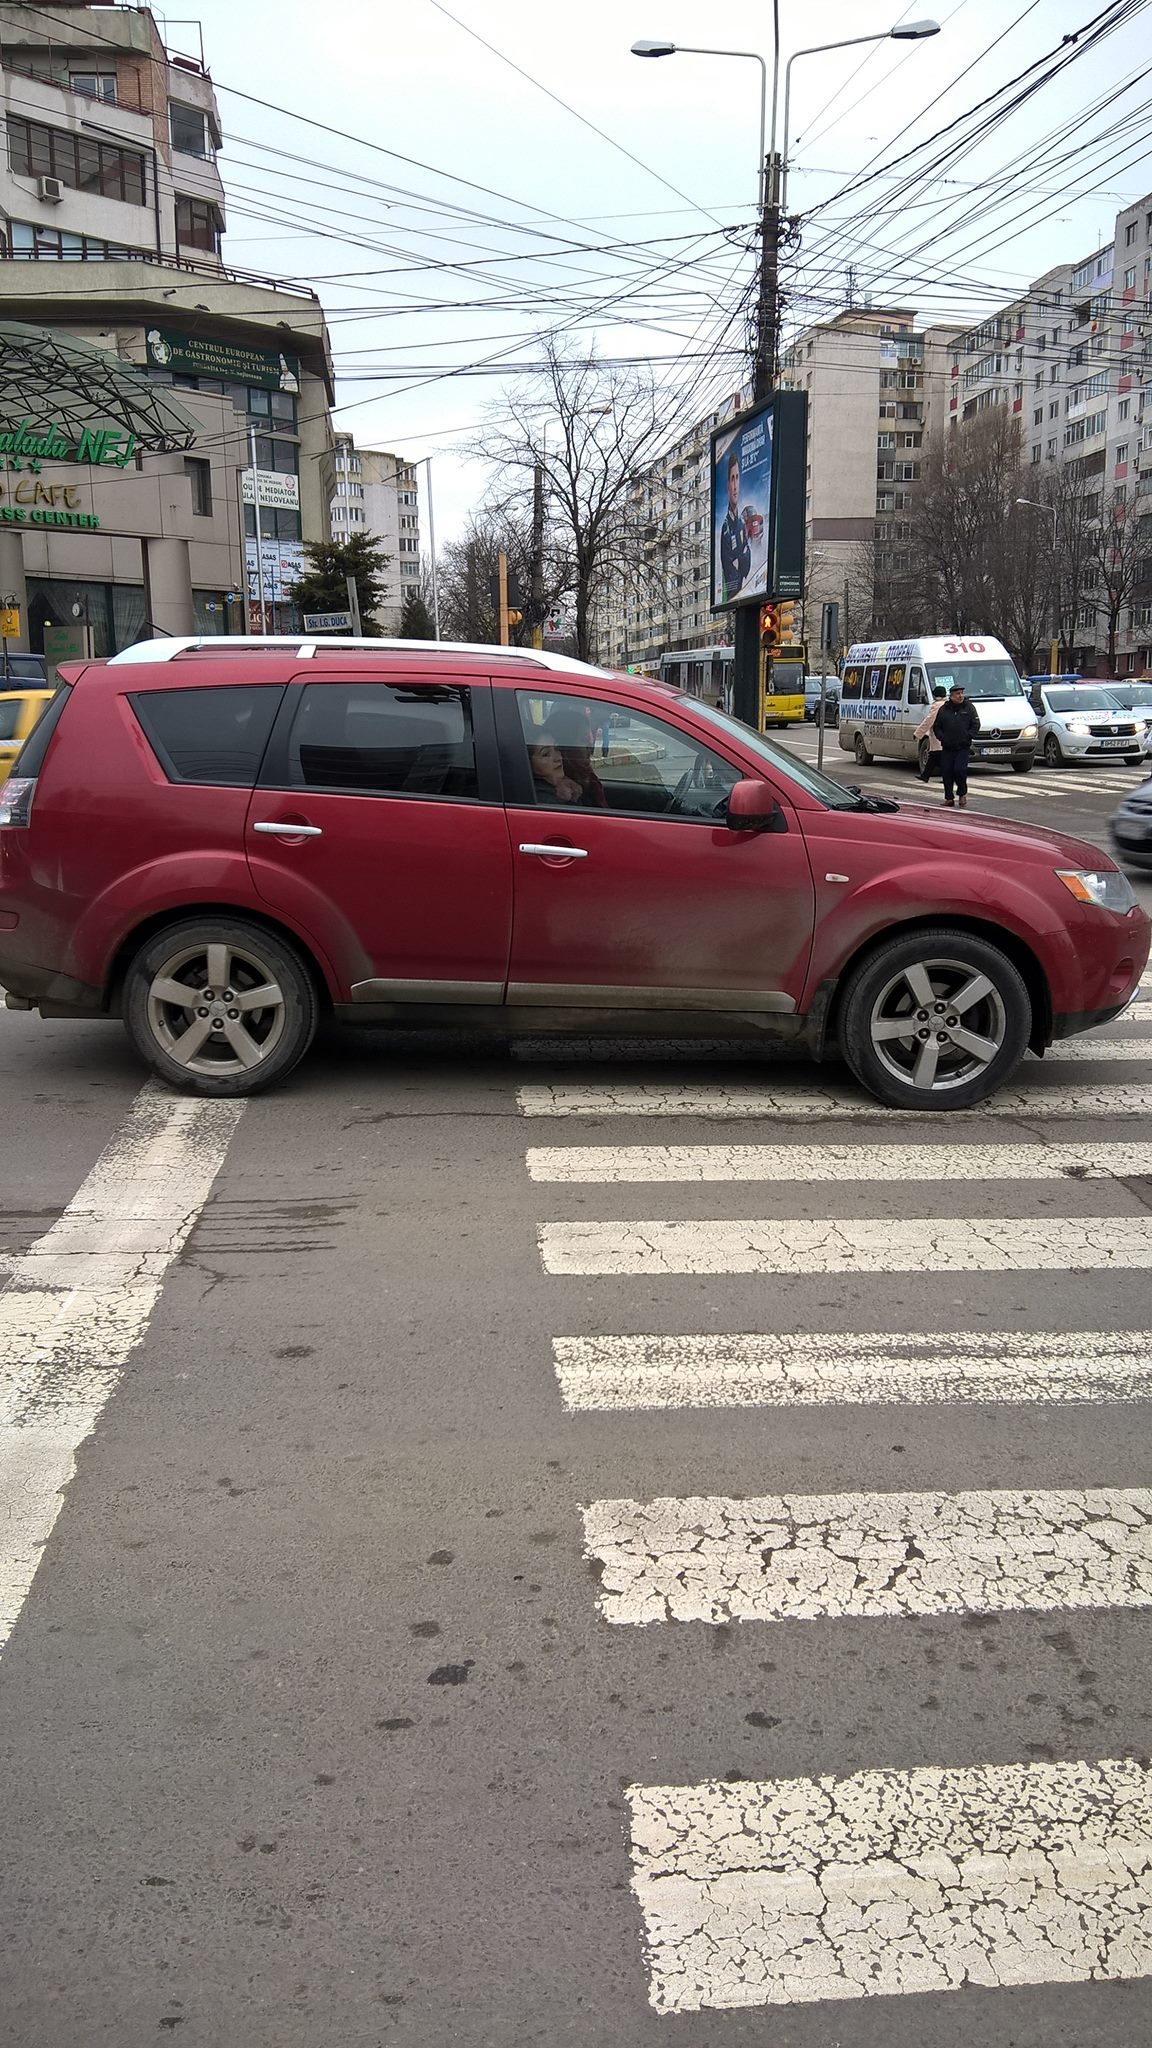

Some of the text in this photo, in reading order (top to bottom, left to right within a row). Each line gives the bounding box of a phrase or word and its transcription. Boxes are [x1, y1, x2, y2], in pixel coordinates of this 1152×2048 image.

[172, 347, 184, 356] DE
[185, 350, 241, 368] GASTRONOMIE
[188, 340, 265, 362] CENTRUL EUROPEAN
[0, 418, 136, 468] alada NEJ
[15, 479, 82, 508] CAFE
[243, 482, 253, 491] OU
[265, 486, 296, 497] MEDIATOR
[260, 494, 298, 506] NEJLOVEANU
[31, 508, 101, 528] CENTER
[331, 616, 348, 626] DUCA
[944, 642, 986, 654] 310
[841, 700, 897, 721] www.sirtrans.ro
